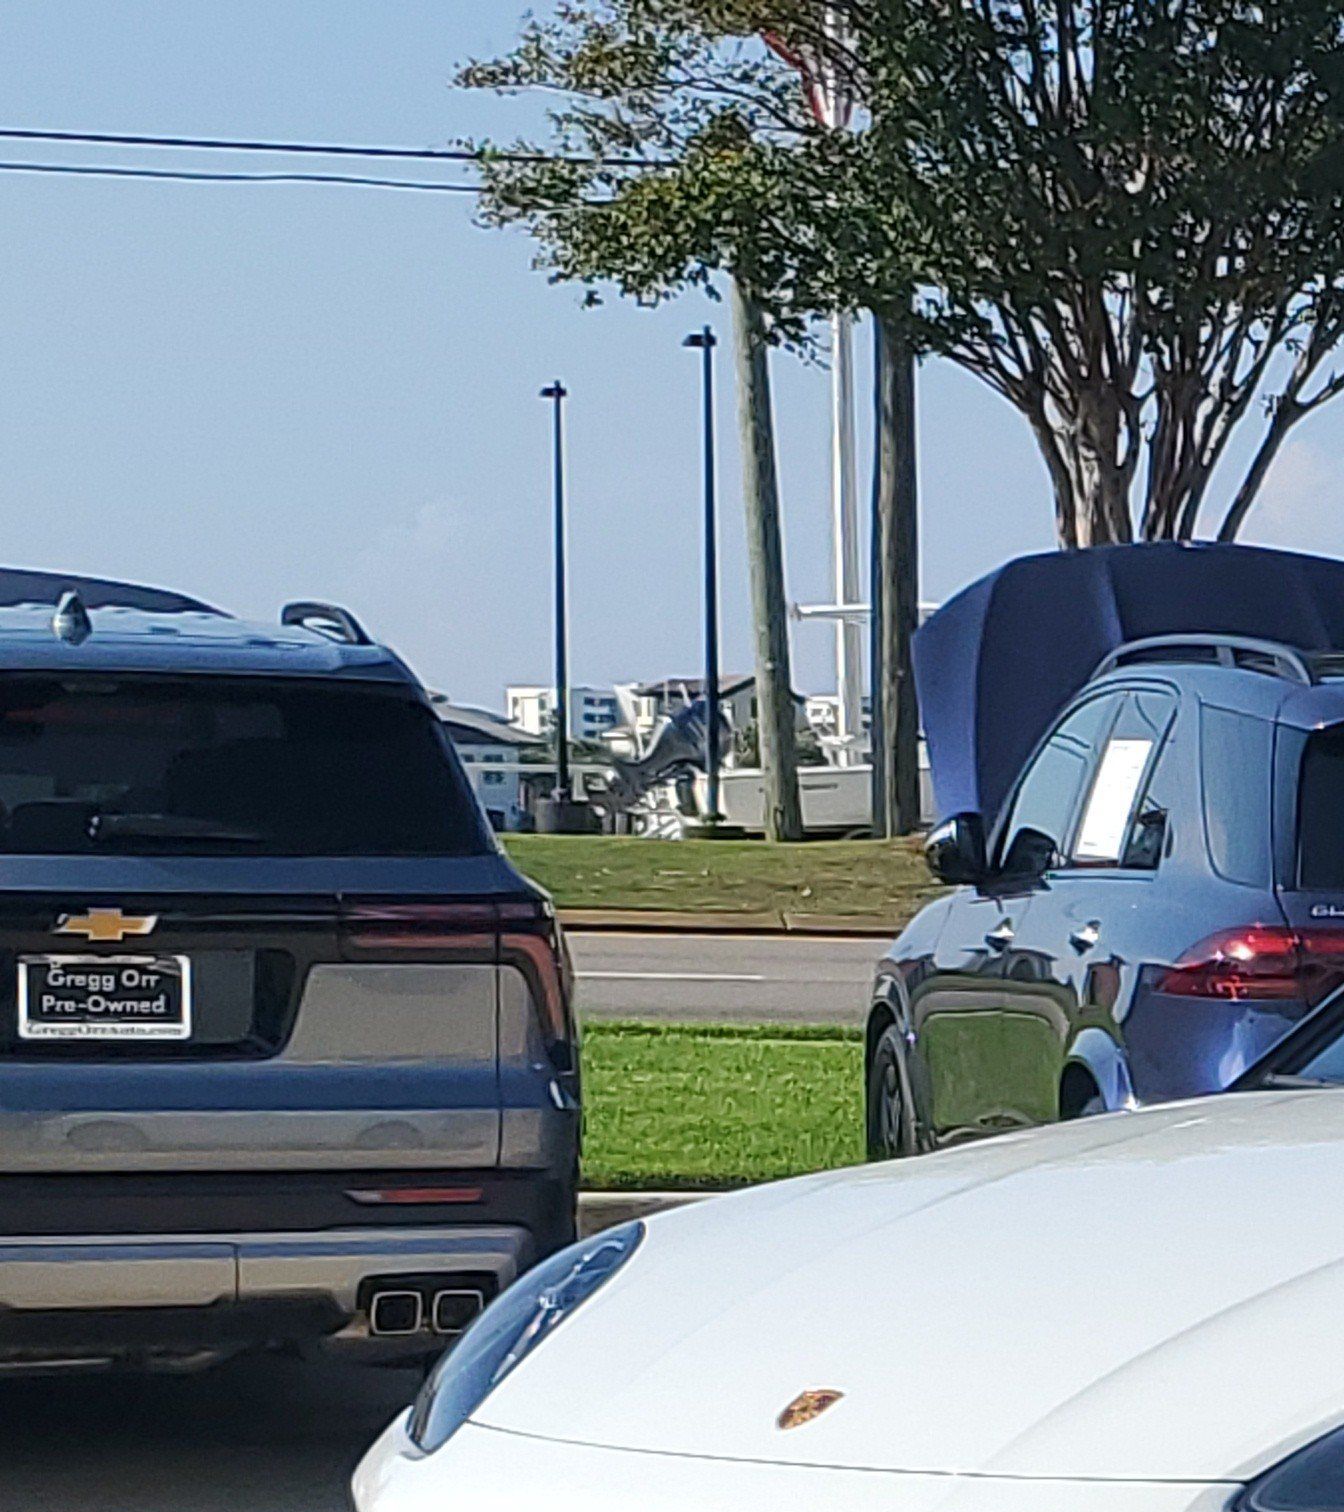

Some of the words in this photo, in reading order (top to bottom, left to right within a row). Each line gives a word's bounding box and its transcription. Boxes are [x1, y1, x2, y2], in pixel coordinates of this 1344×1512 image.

[47, 969, 115, 992] Gregg
[121, 969, 160, 987] Orr
[41, 994, 166, 1013] Pre-Owned
